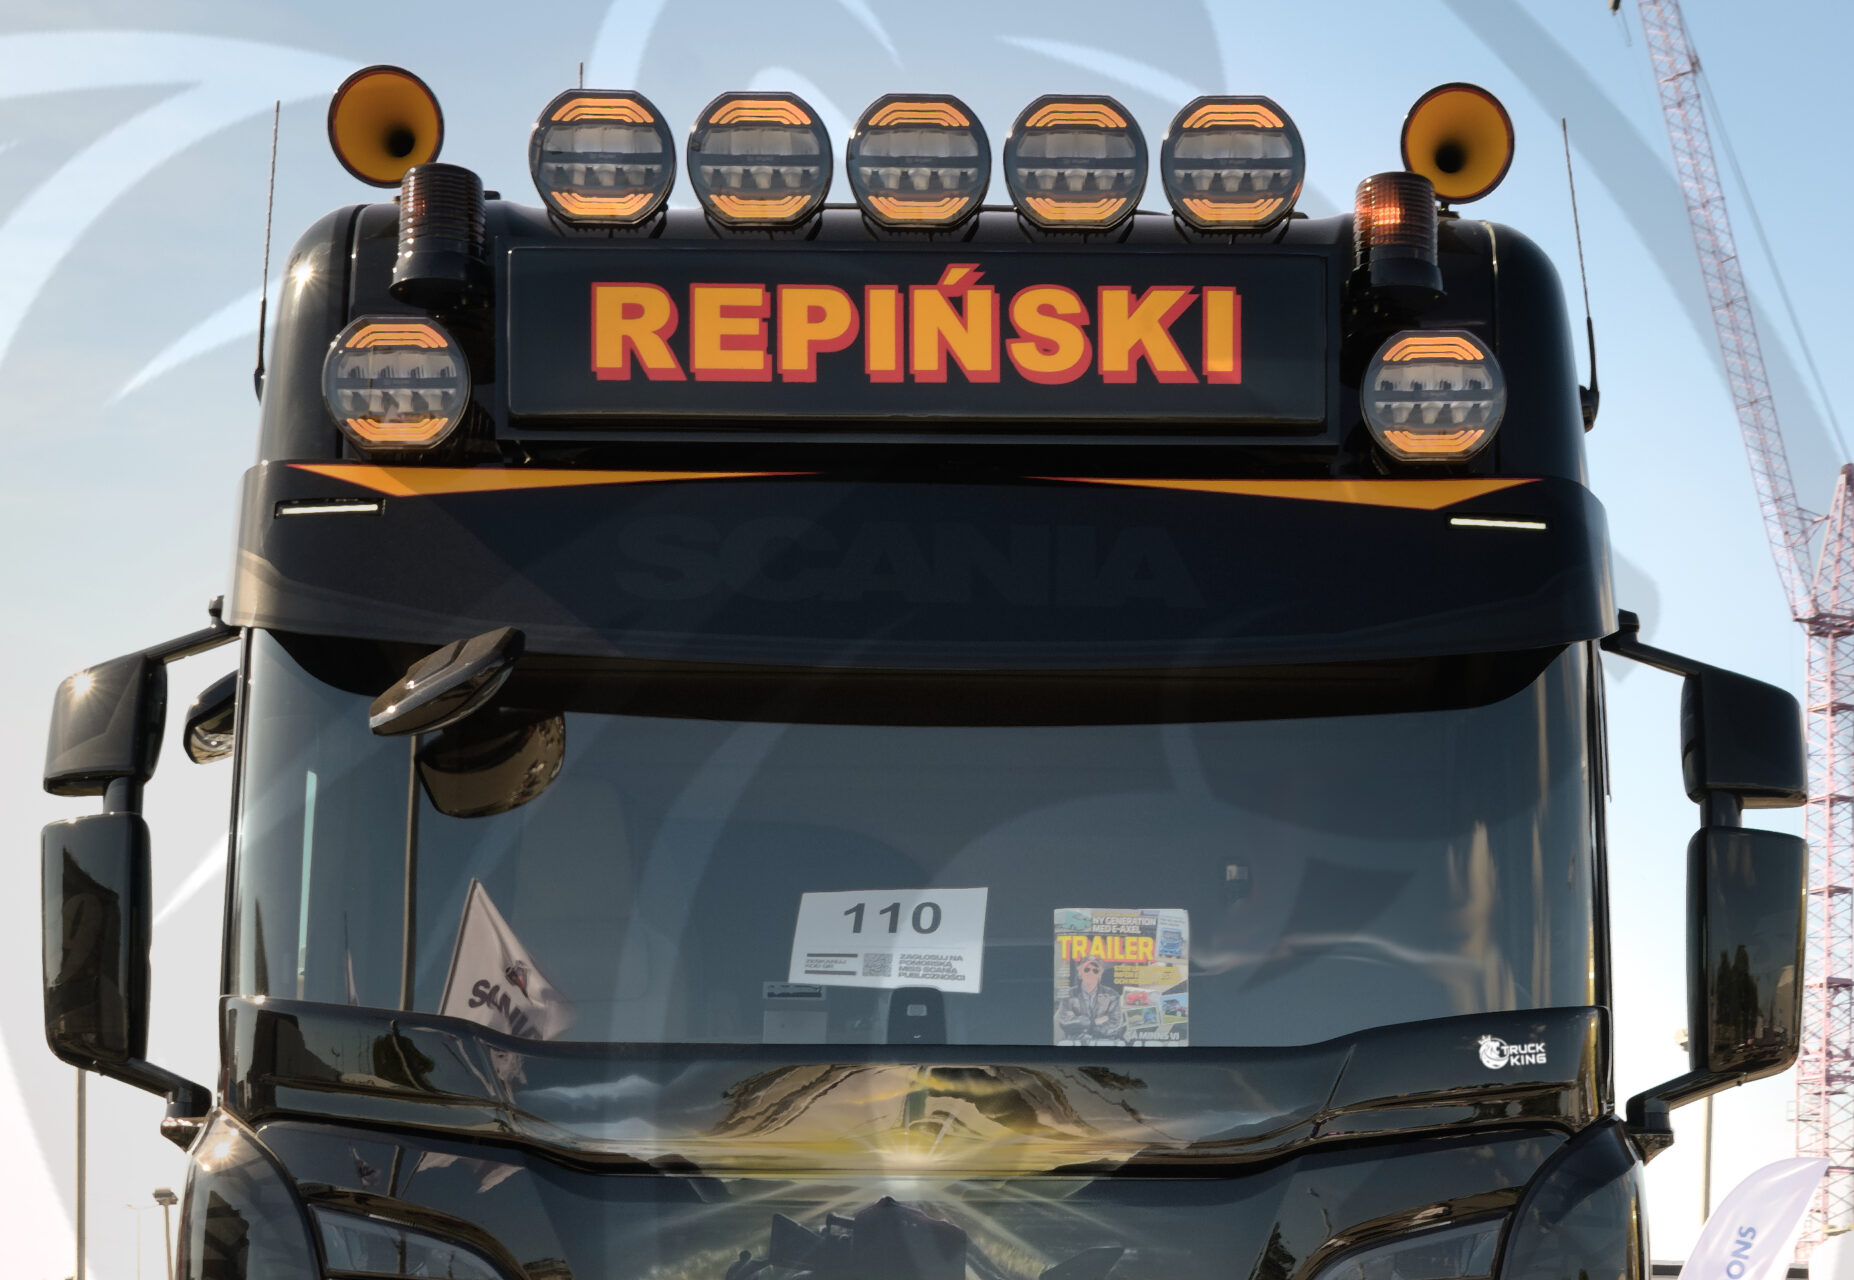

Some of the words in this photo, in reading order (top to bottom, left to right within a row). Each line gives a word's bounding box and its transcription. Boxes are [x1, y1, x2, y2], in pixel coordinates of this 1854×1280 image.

[591, 263, 1242, 384] REPIŃSKI
[612, 512, 1208, 609] SCANIA
[844, 902, 942, 934] 110
[1056, 935, 1156, 963] TRAILER
[1500, 1043, 1546, 1055] TRUCK
[1510, 1053, 1547, 1066] KING
